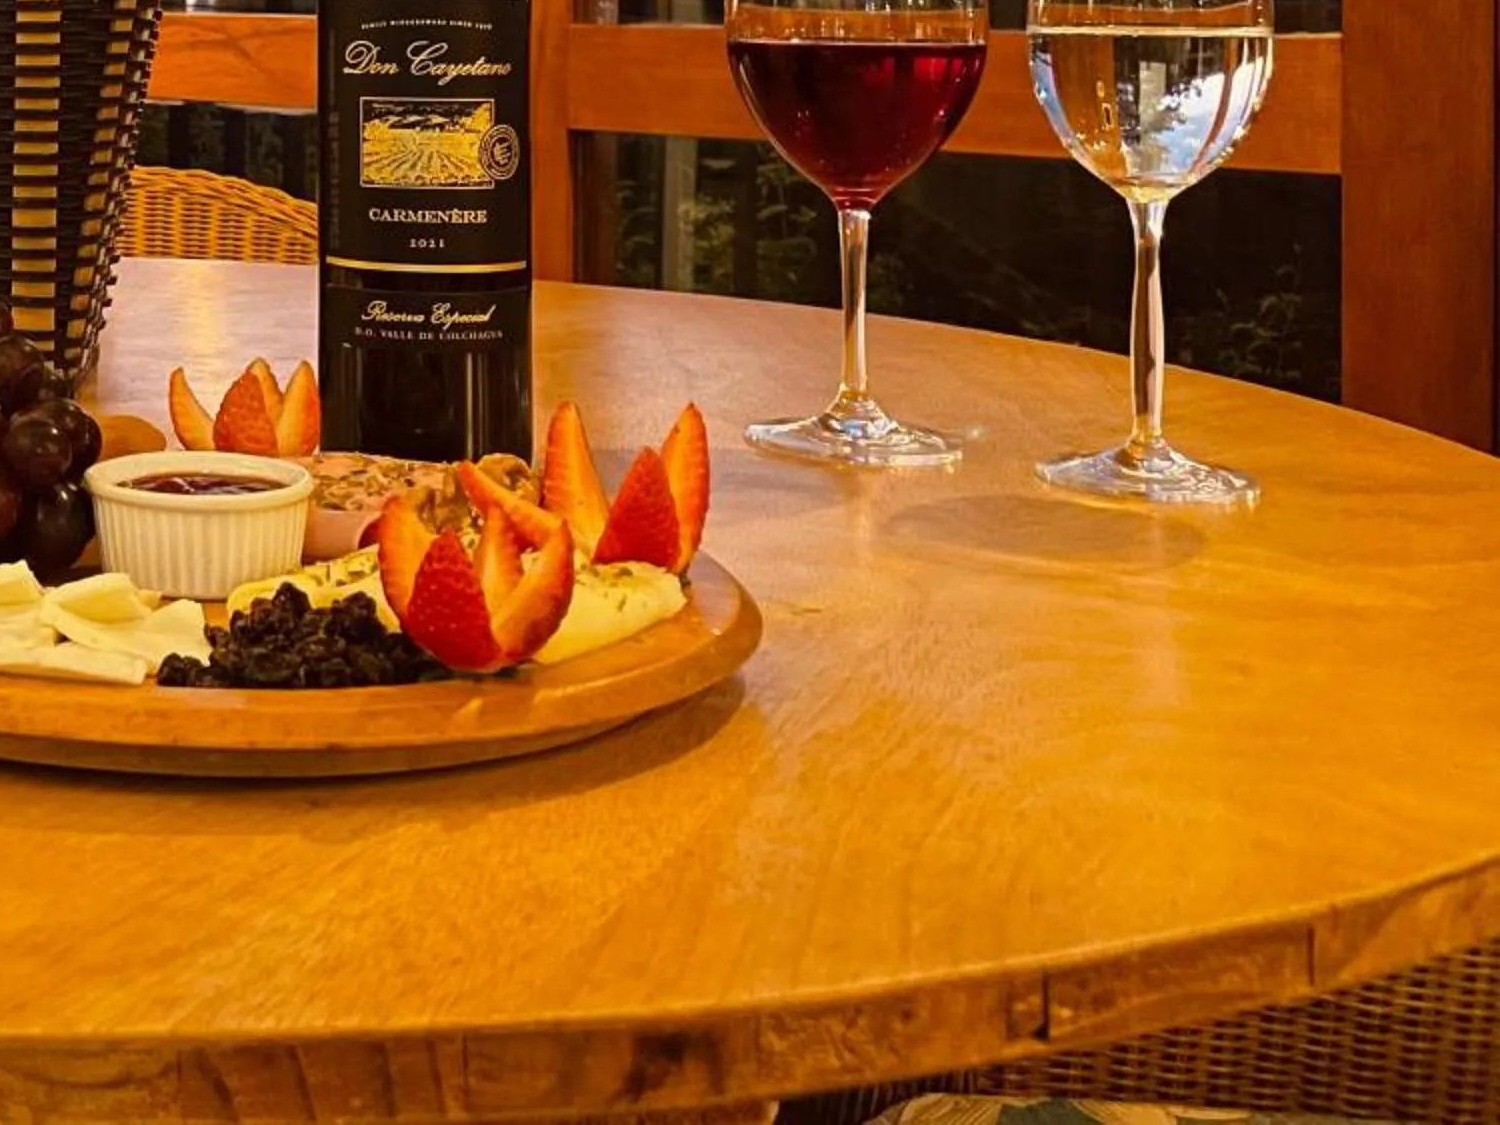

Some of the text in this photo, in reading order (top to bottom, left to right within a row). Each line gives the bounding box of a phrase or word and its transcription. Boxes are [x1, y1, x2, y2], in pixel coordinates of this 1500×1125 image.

[343, 40, 512, 86] Don Cayetano
[369, 207, 488, 224] CARMENÈRE
[409, 238, 445, 248] 2021
[361, 300, 497, 330] Reserva Especial
[418, 332, 433, 340] DE
